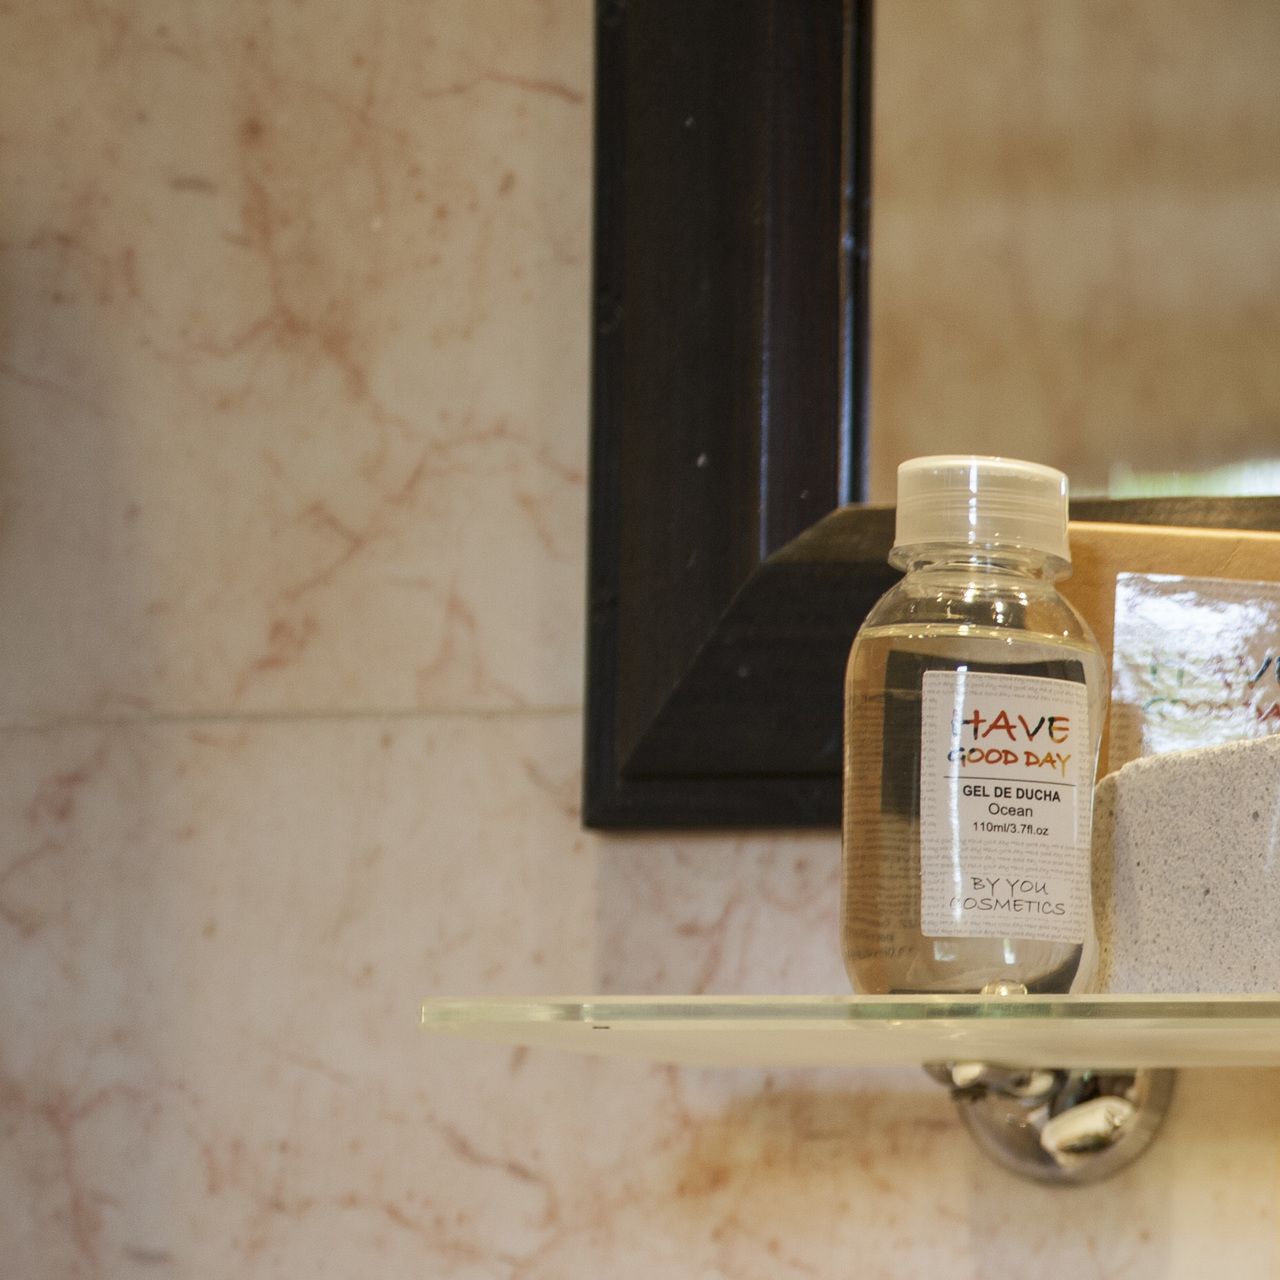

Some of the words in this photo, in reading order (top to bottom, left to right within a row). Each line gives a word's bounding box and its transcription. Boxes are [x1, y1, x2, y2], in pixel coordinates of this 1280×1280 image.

[951, 709, 1070, 744] HAVE
[947, 747, 1019, 768] GOOD
[1024, 751, 1071, 778] DAY
[962, 785, 990, 798] GEL
[993, 787, 1012, 799] DE
[1016, 788, 1061, 803] DUCHA
[988, 803, 1033, 818] Ocean
[972, 821, 1048, 837] 110ml/3.7fl.oz
[971, 876, 1000, 896] BY
[1007, 879, 1048, 897] YOU
